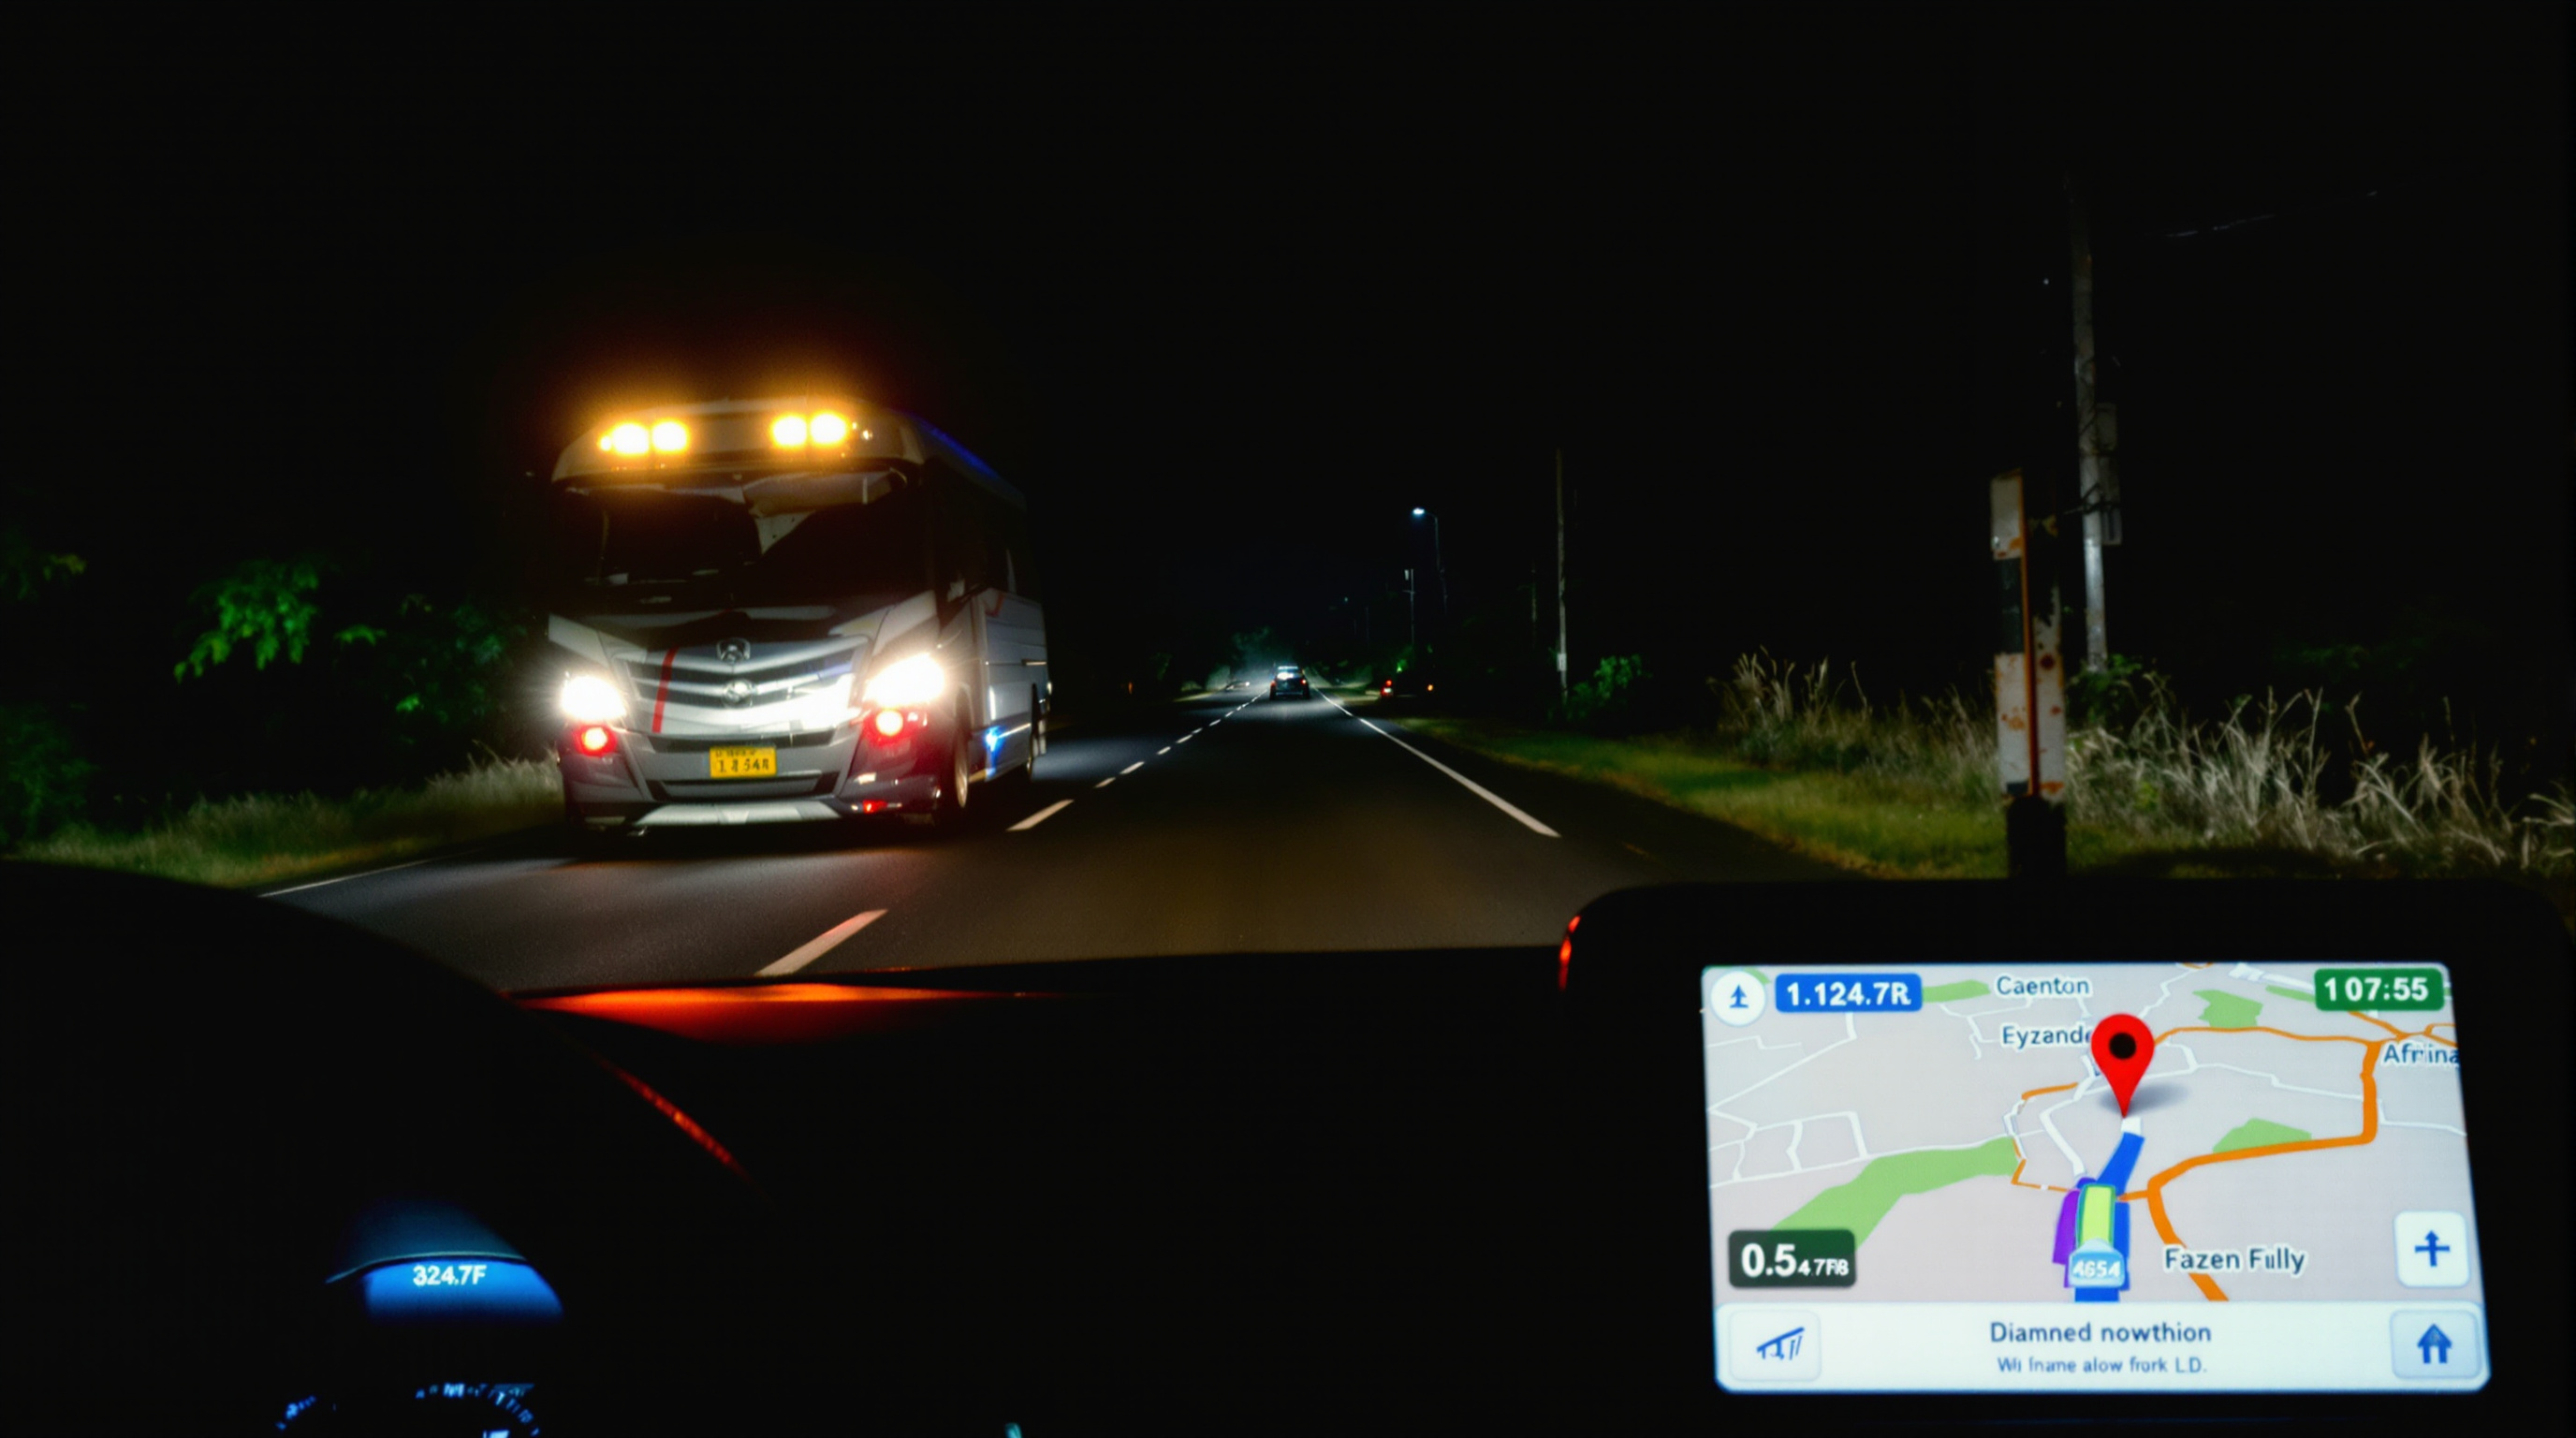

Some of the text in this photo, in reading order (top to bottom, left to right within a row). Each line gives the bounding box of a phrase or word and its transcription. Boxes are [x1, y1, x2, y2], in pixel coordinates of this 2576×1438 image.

[1787, 981, 1911, 1006] 1.124.7R
[1997, 976, 2089, 995] Caenton
[2165, 1248, 2240, 1269] Fazen
[413, 1264, 487, 1286] 324.7F
[1990, 1321, 2212, 1343] Diamned nowthion
